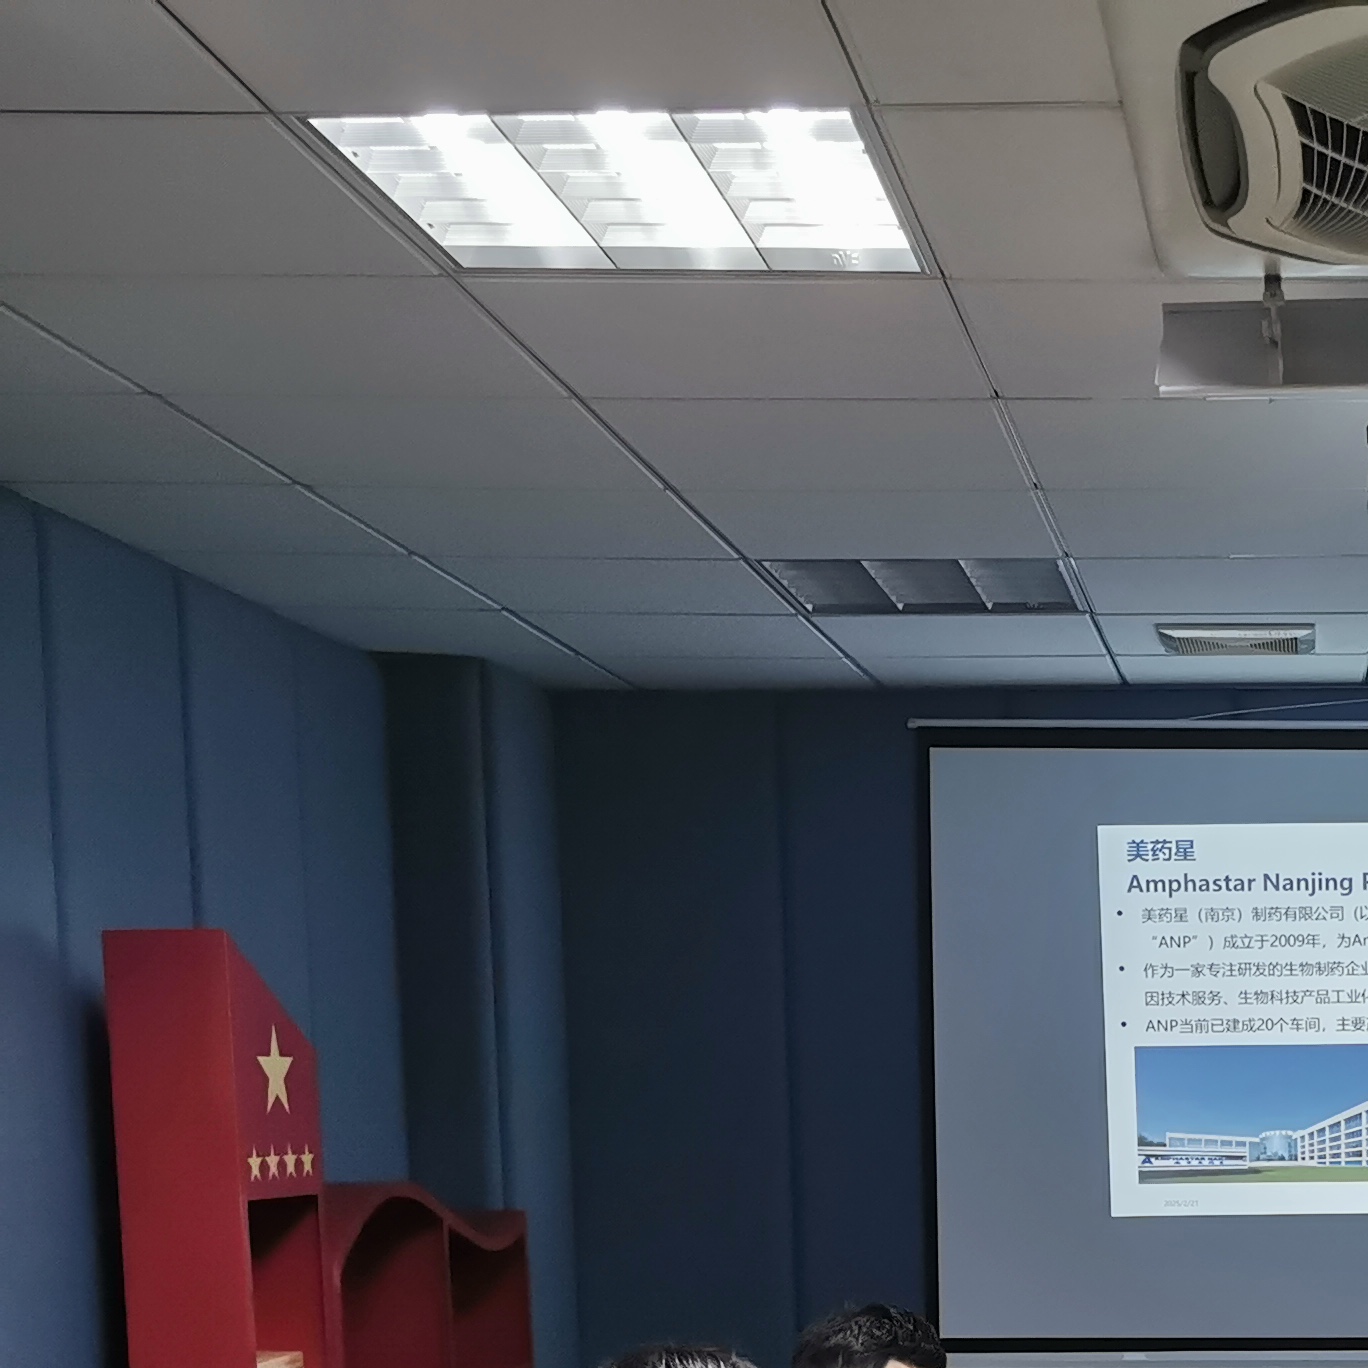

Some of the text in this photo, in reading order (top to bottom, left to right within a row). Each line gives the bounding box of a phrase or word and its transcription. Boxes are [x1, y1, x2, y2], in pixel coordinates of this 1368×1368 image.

[1126, 839, 1196, 862] 美药星
[1127, 873, 1256, 898] Amphastar
[1264, 872, 1353, 897] Nanjing
